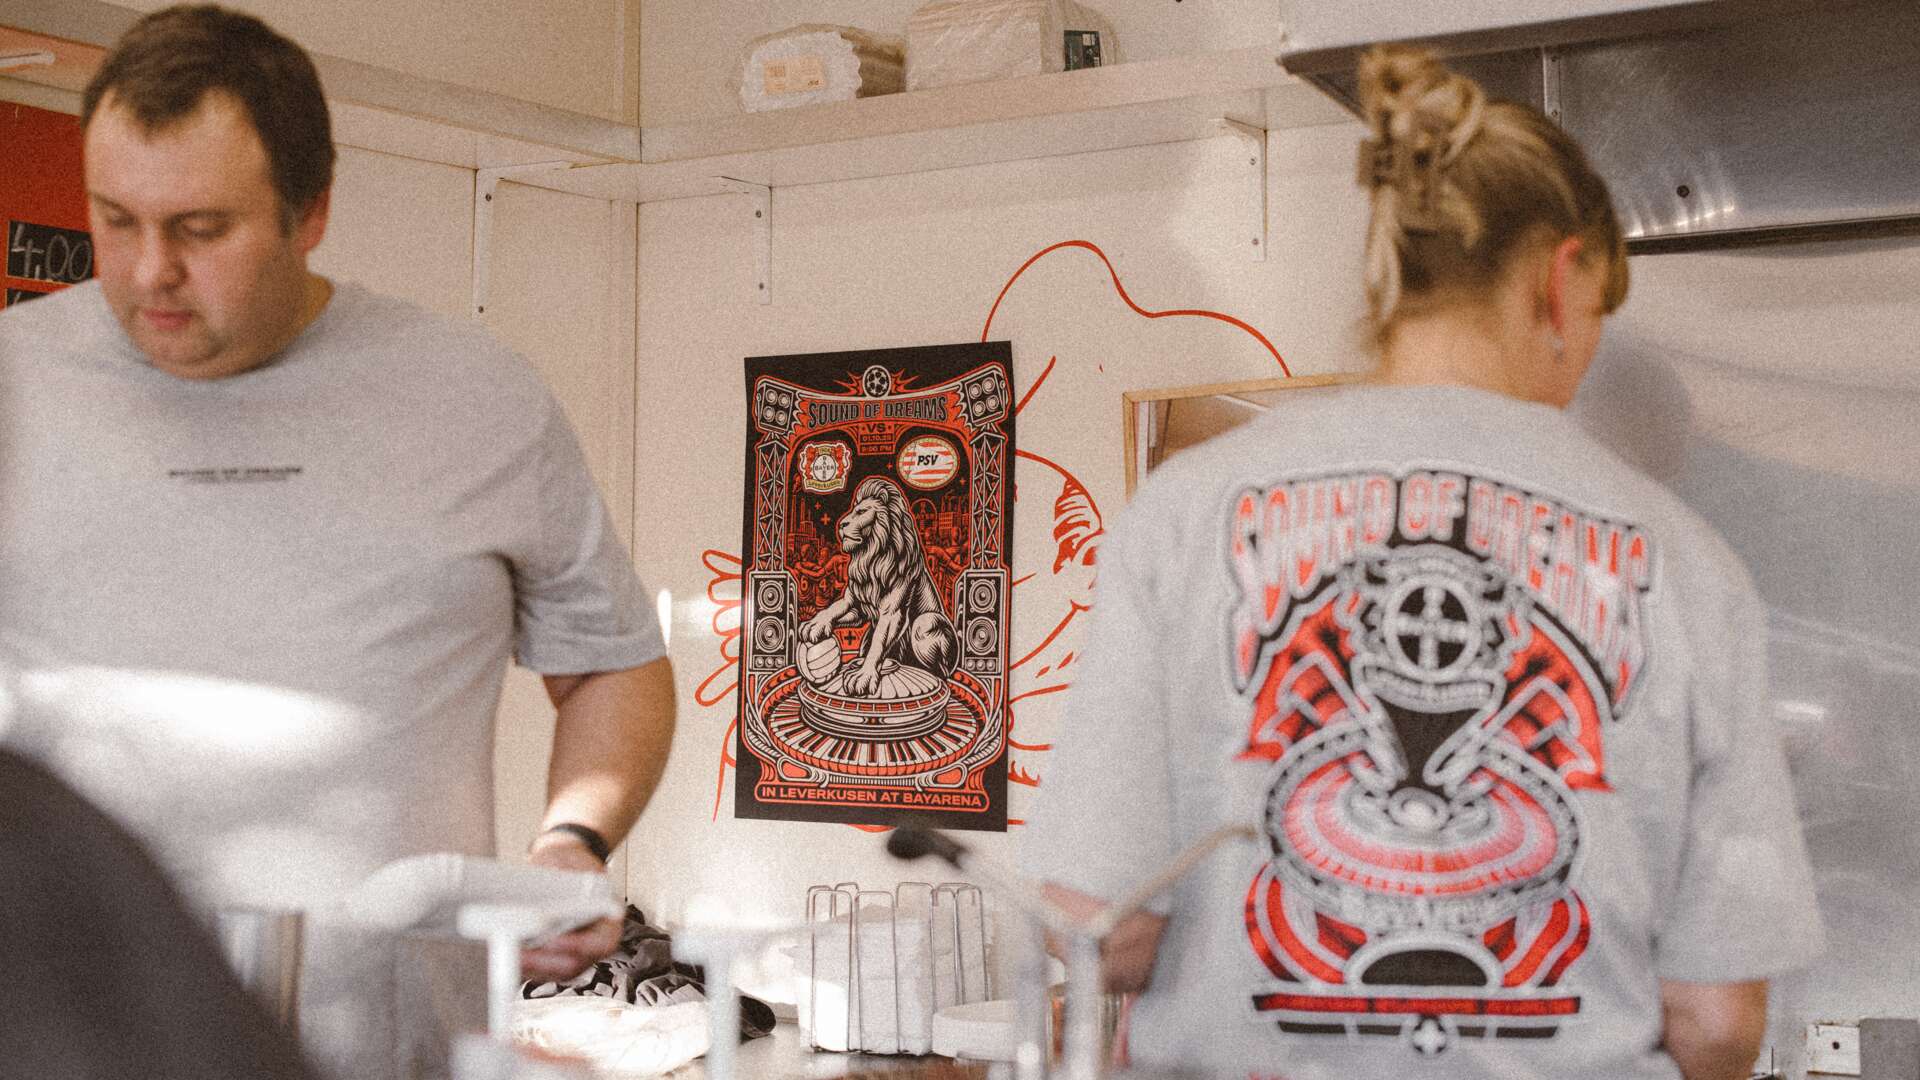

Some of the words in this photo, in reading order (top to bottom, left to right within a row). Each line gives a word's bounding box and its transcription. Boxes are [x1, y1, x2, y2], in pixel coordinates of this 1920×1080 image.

[808, 402, 859, 429] SOUND
[864, 403, 880, 418] OF
[884, 396, 947, 421] DREAMS
[867, 423, 885, 432] VS
[917, 454, 938, 466] PSV
[1401, 472, 1464, 541] OF
[762, 786, 776, 797] IN
[780, 787, 877, 802] LEVERKUSEN
[880, 792, 898, 802] AT
[903, 792, 982, 806] BAYARENA
